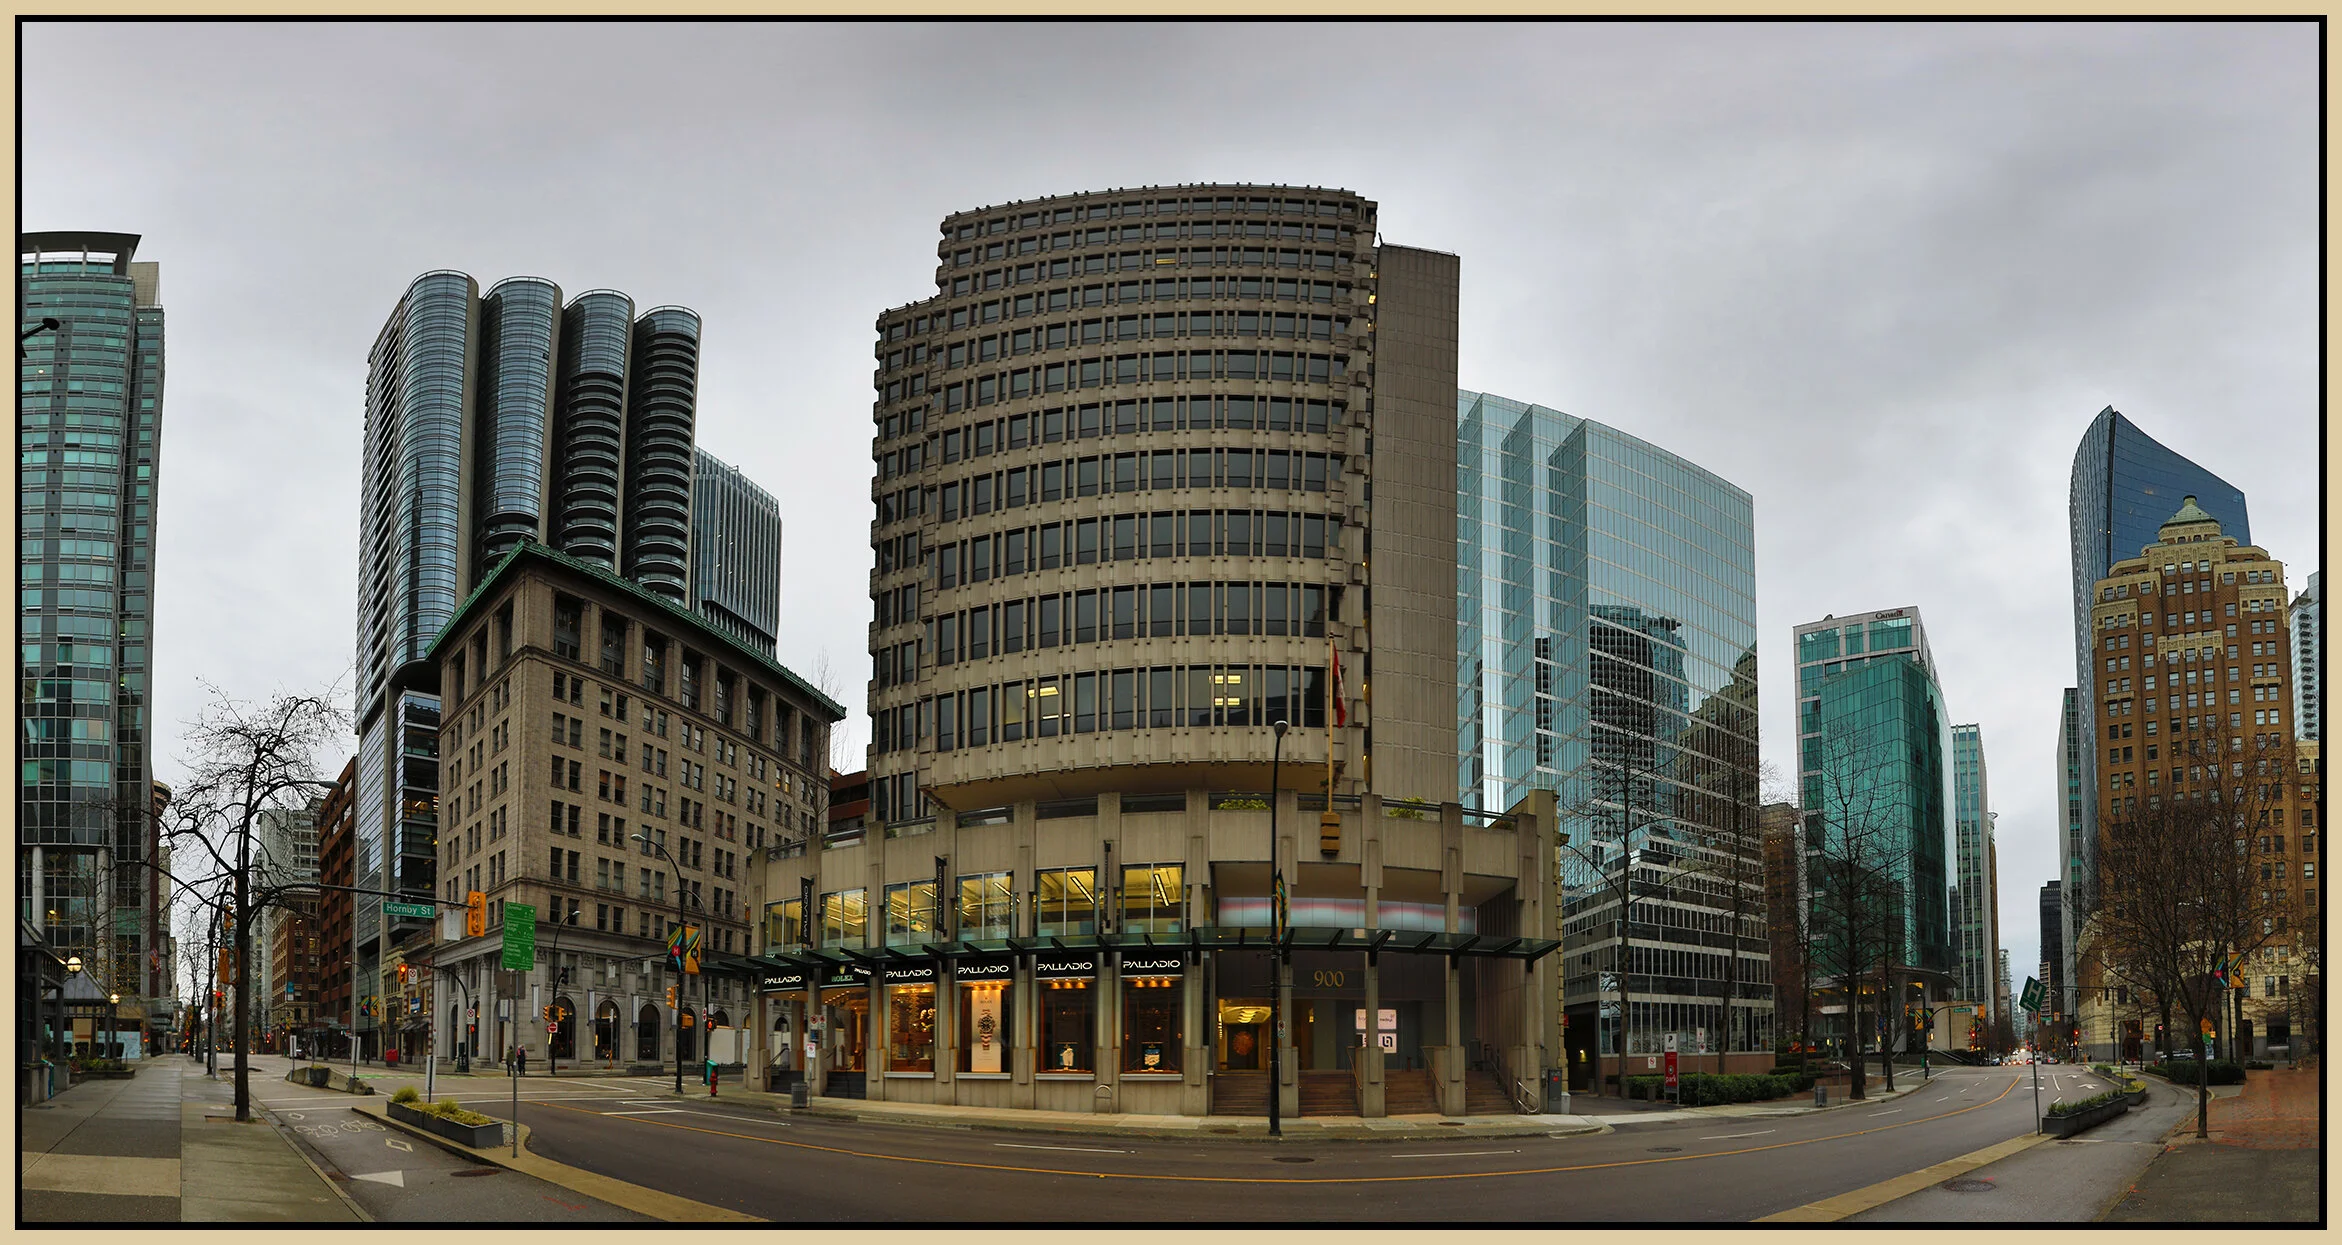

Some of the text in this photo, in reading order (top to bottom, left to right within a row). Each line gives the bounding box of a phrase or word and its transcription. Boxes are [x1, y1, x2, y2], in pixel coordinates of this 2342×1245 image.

[386, 903, 431, 915] Hornby St
[1037, 962, 1093, 971] PALLADIO
[1123, 960, 1181, 968] PALLADIO
[886, 969, 932, 978] PALLADIO
[958, 965, 1009, 974] PALLADIO
[764, 975, 802, 984] PALLADIO
[831, 974, 854, 982] ROLEX
[1314, 970, 1345, 987] 900
[2027, 981, 2043, 1003] H
